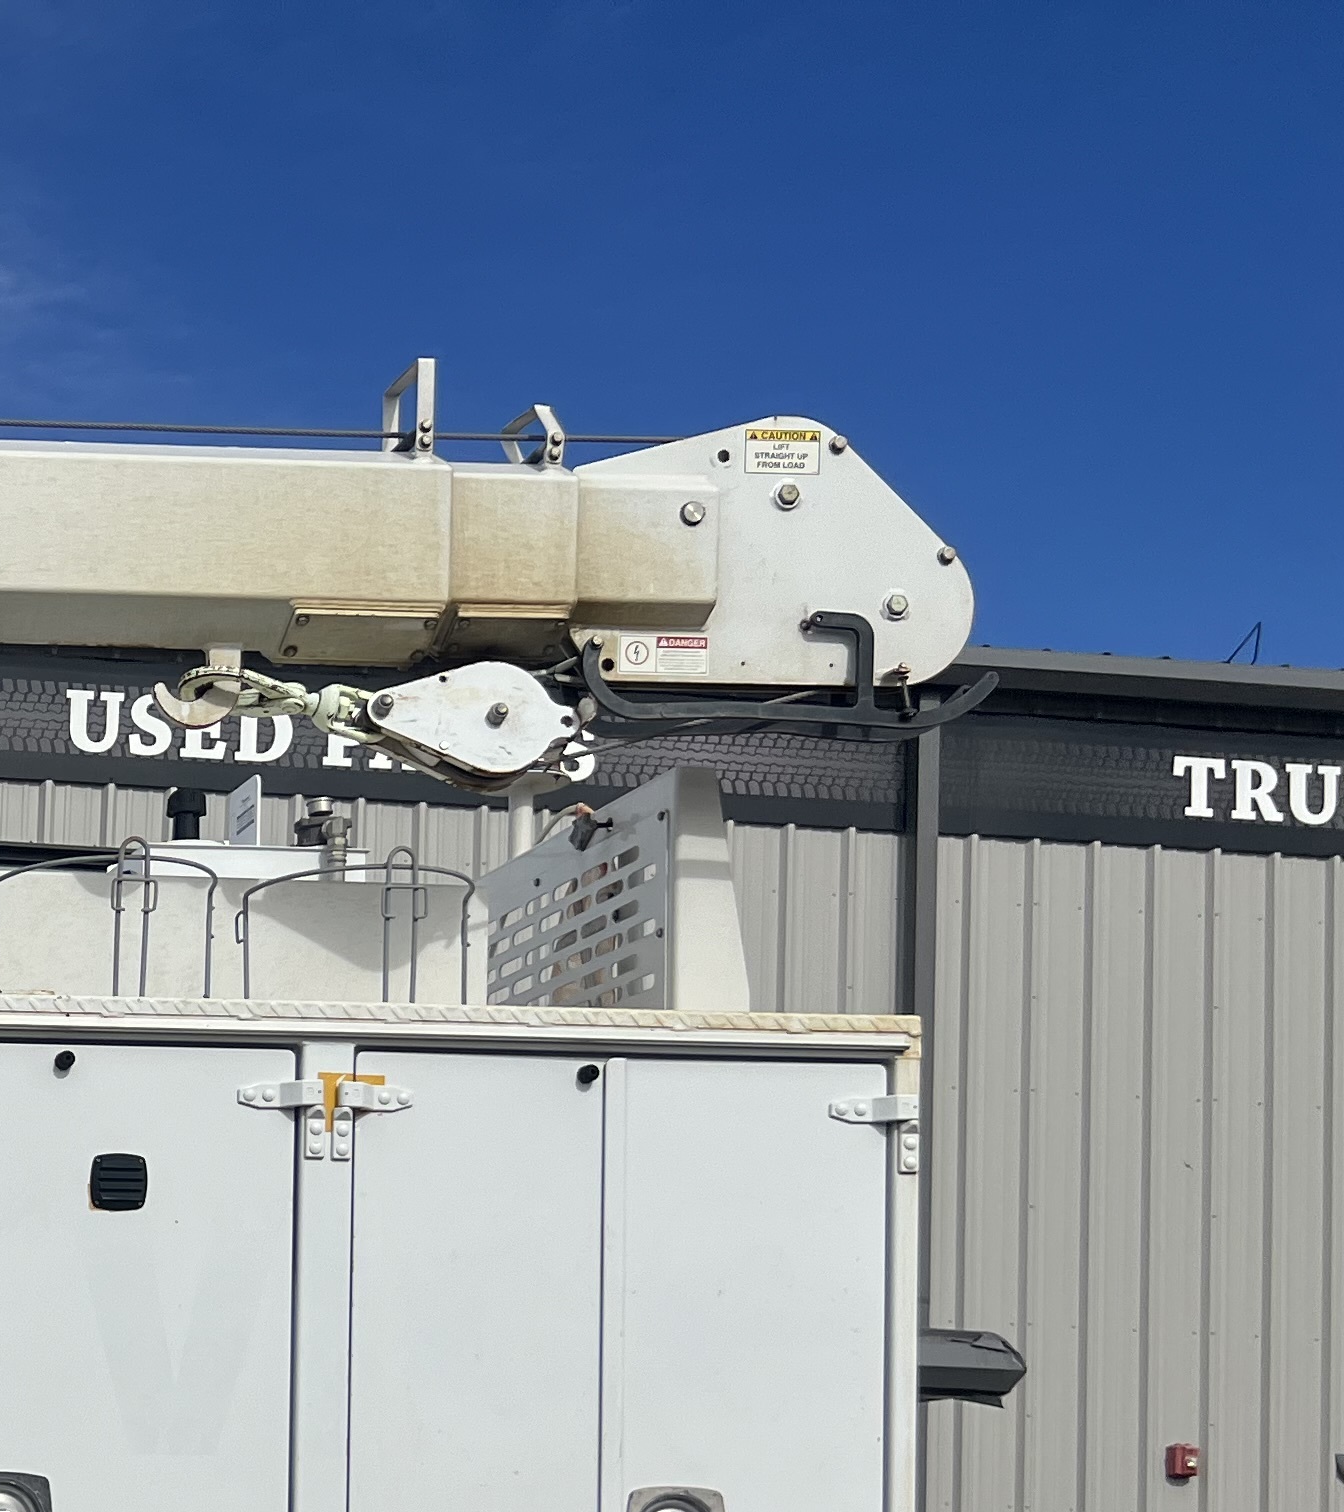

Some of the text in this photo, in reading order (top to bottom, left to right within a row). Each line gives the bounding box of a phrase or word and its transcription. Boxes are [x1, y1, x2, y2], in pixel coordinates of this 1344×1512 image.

[761, 431, 806, 440] CAUTION
[773, 443, 790, 451] LIFT
[754, 452, 796, 460] STRAIGHT
[756, 461, 781, 469] FROM
[669, 639, 706, 647] DANGER
[66, 689, 294, 762] USED
[1172, 755, 1342, 825] TRU
